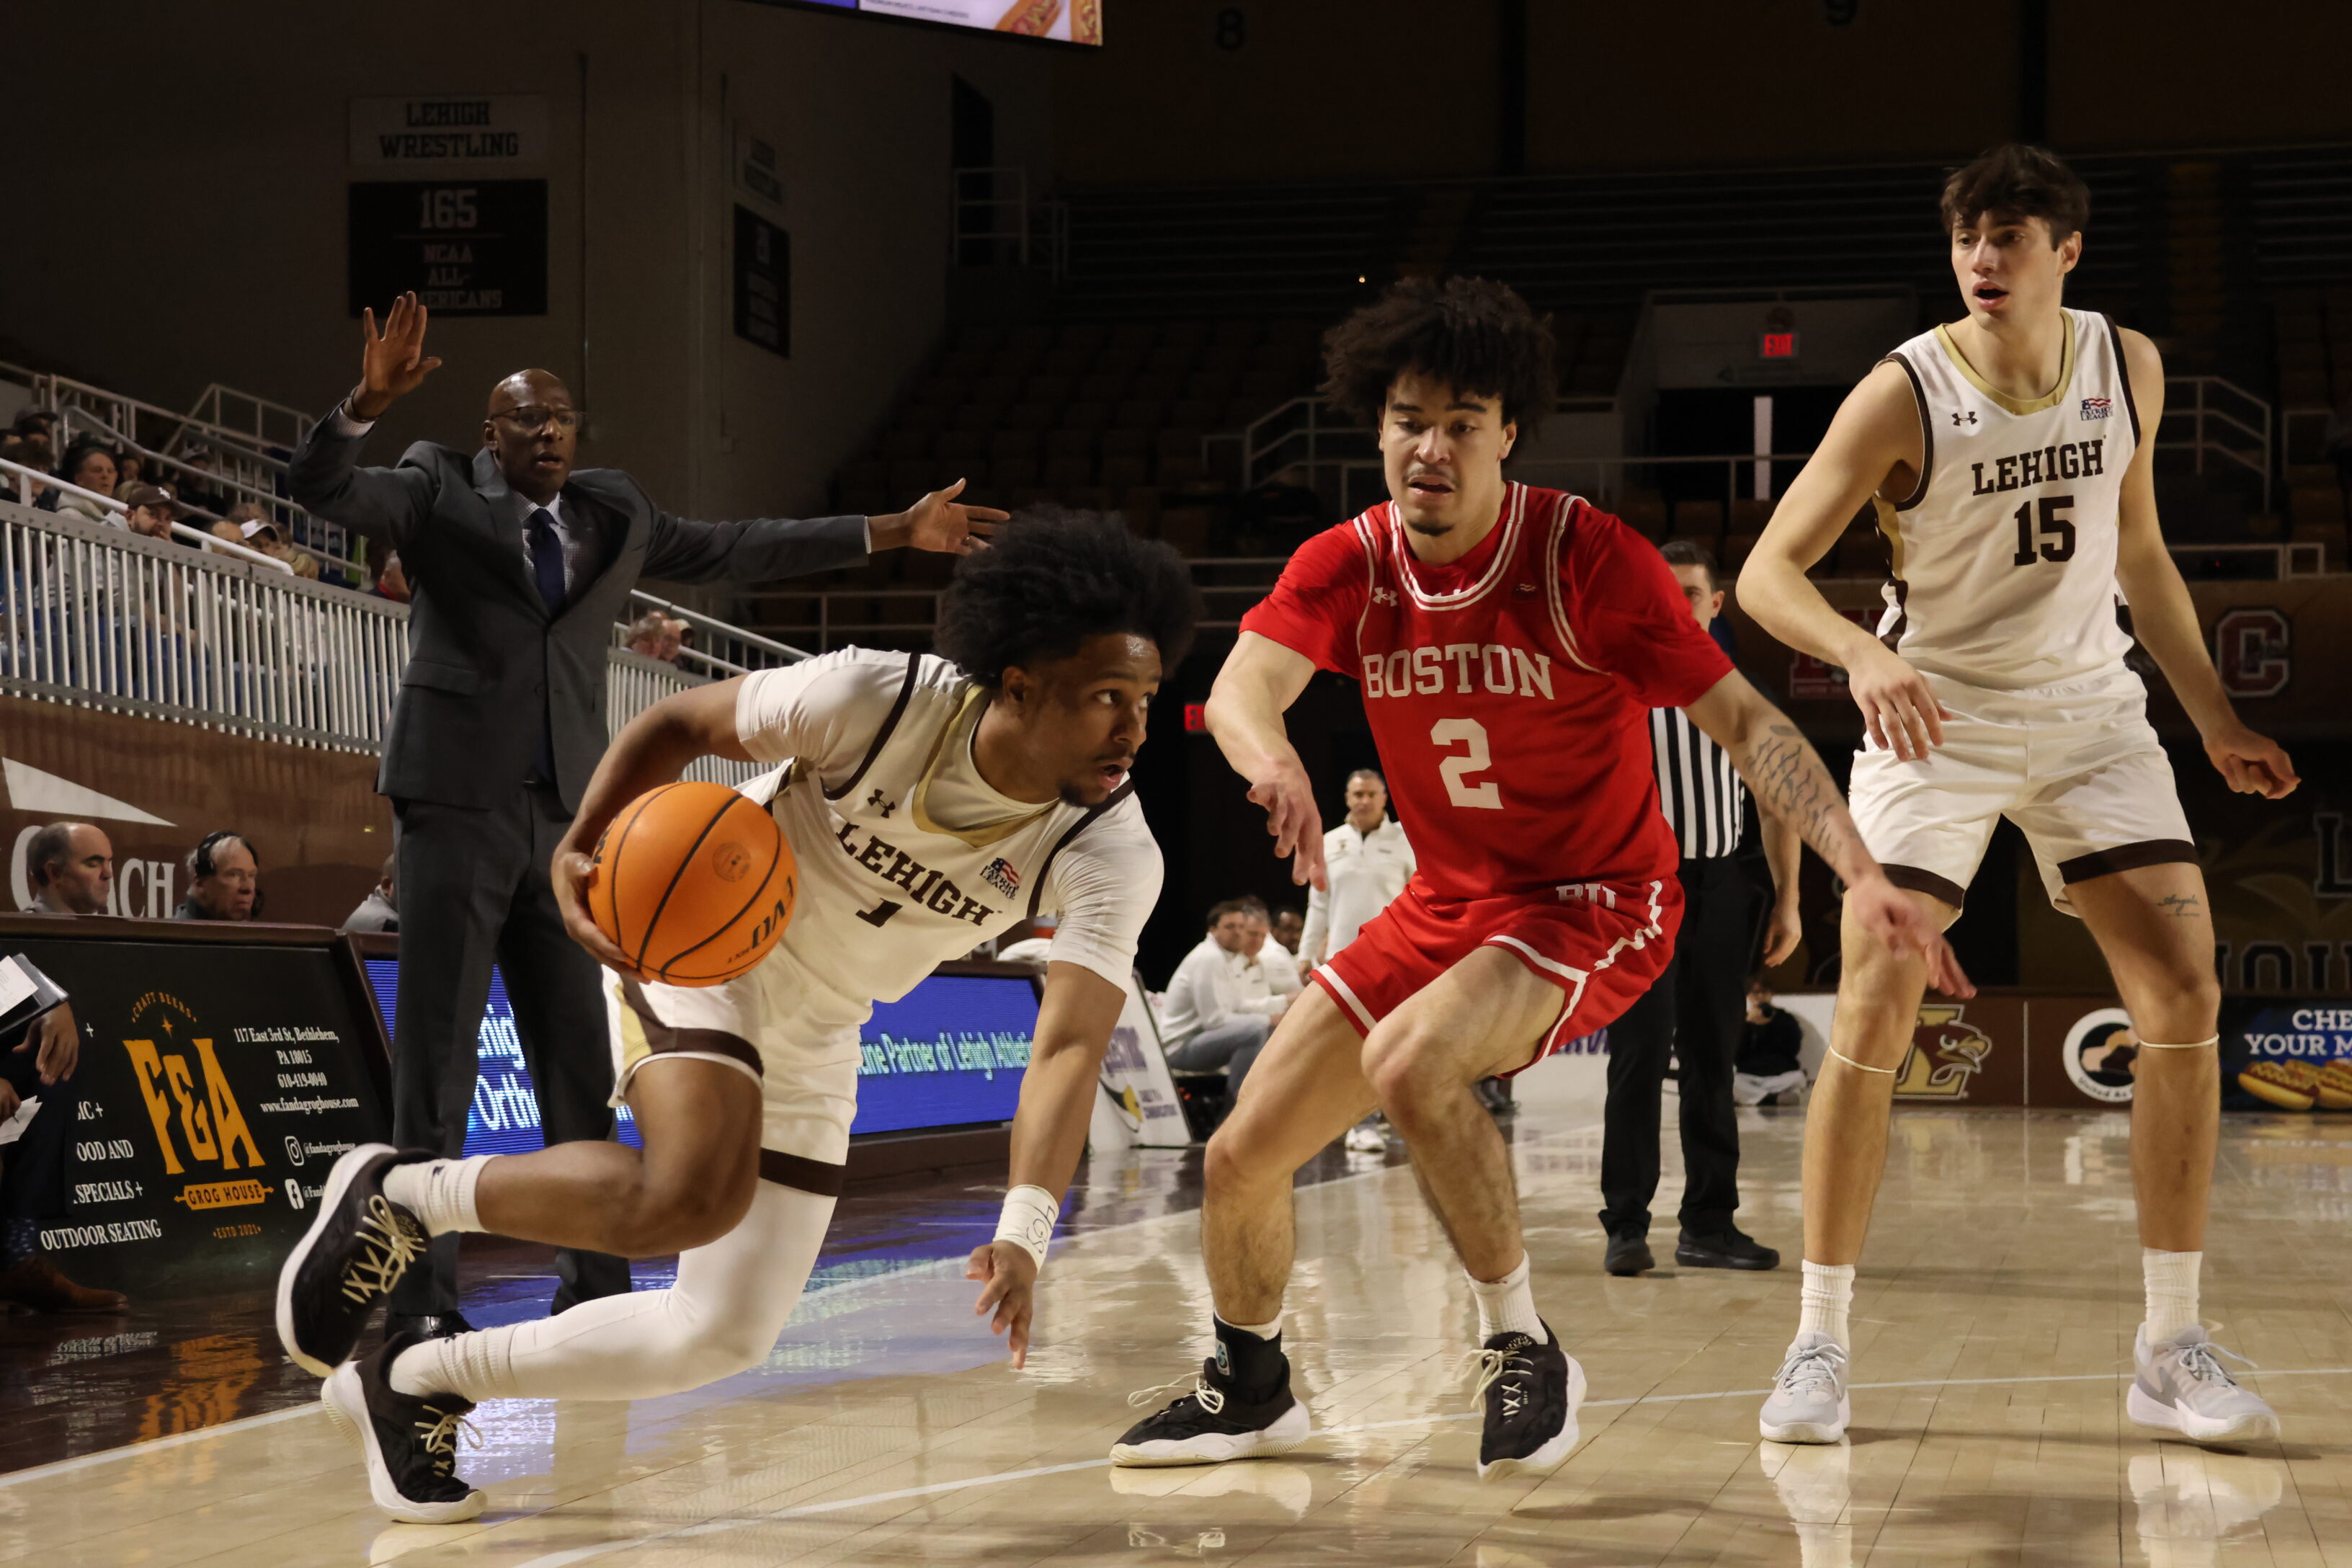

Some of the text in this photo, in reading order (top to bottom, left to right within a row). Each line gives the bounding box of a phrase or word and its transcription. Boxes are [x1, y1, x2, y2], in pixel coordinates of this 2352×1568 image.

[1218, 8, 1241, 49] 8
[406, 102, 491, 127] LEHIGH
[379, 133, 519, 159] WRESTLING
[419, 188, 478, 230] 165
[422, 244, 473, 264] NCAA
[1764, 334, 1794, 357] EXIT
[1972, 440, 2103, 496] LEHIGH
[2014, 495, 2075, 566] 15
[1363, 643, 1555, 700] BOSTON
[1430, 718, 1505, 810] 2
[836, 822, 994, 926] LEHIGH
[133, 992, 192, 1018] CRAFT BEERS
[233, 1028, 249, 1043] 117
[249, 1028, 270, 1043] East
[267, 1027, 284, 1042] 3rd
[293, 1027, 339, 1043] Bethlehem,
[2243, 1033, 2328, 1056] YOUR
[276, 1049, 313, 1065] PA 18015
[935, 1032, 955, 1072] of
[946, 1031, 997, 1081] Lehigh
[121, 1038, 266, 1175] F&A
[259, 1095, 360, 1115] www.fandagroghouse.com
[76, 1139, 135, 1162] OOD AND
[188, 1184, 262, 1206] GROG HOUSE
[40, 1219, 162, 1251] OUTDOOR SEATING
[216, 1226, 238, 1239] ESTD
